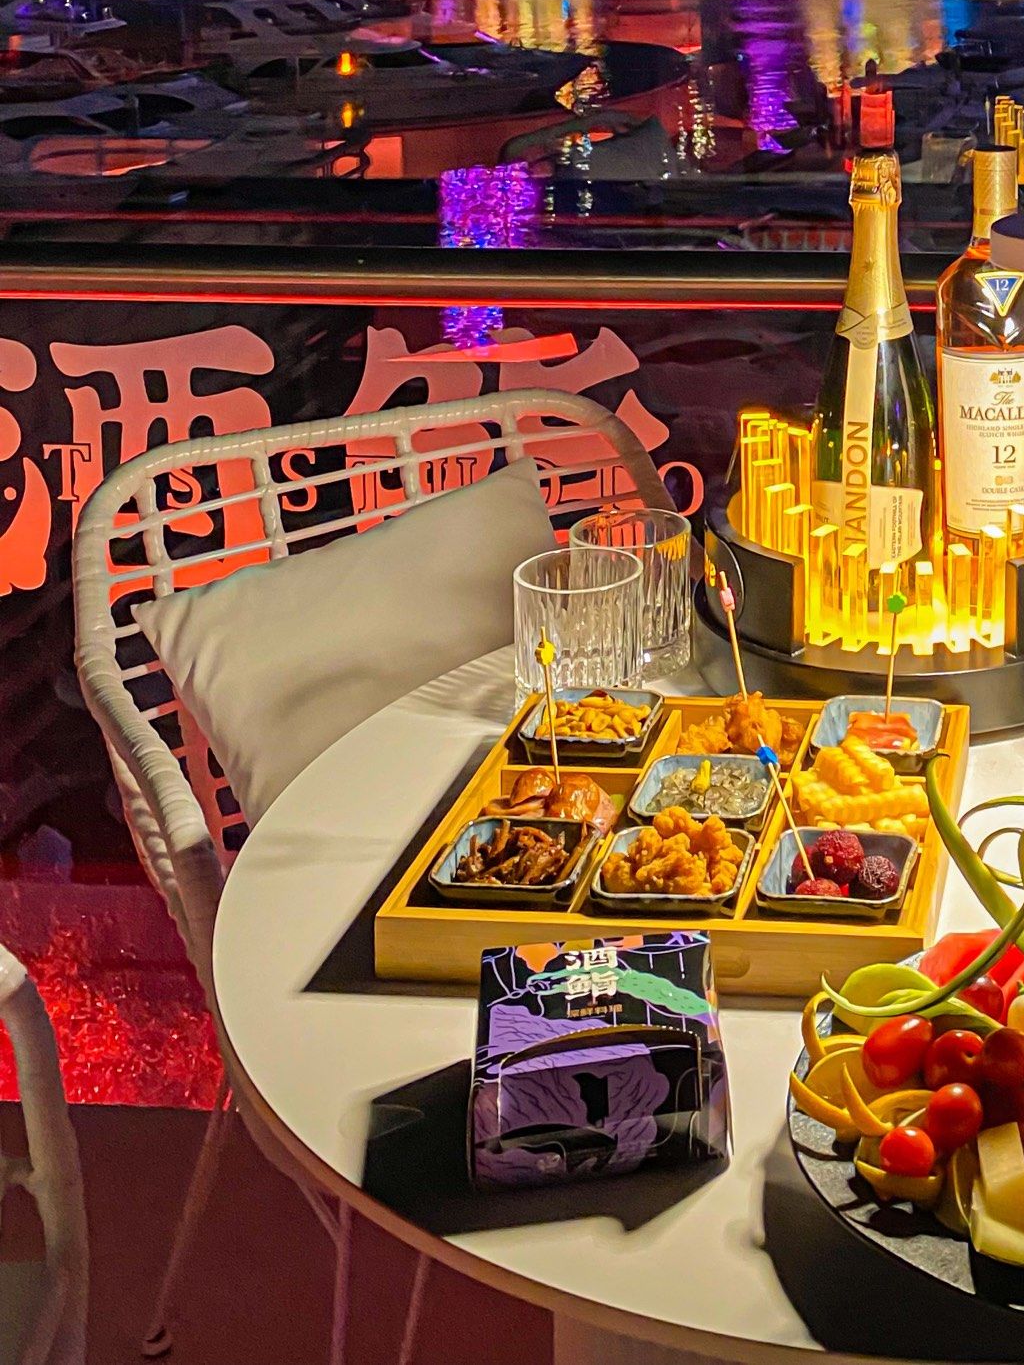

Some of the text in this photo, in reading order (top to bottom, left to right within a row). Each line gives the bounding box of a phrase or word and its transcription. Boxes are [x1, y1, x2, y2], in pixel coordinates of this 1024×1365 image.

[995, 279, 1009, 291] 12
[991, 391, 1015, 406] The
[992, 444, 1016, 465] 12
[845, 421, 869, 544] ANDON
